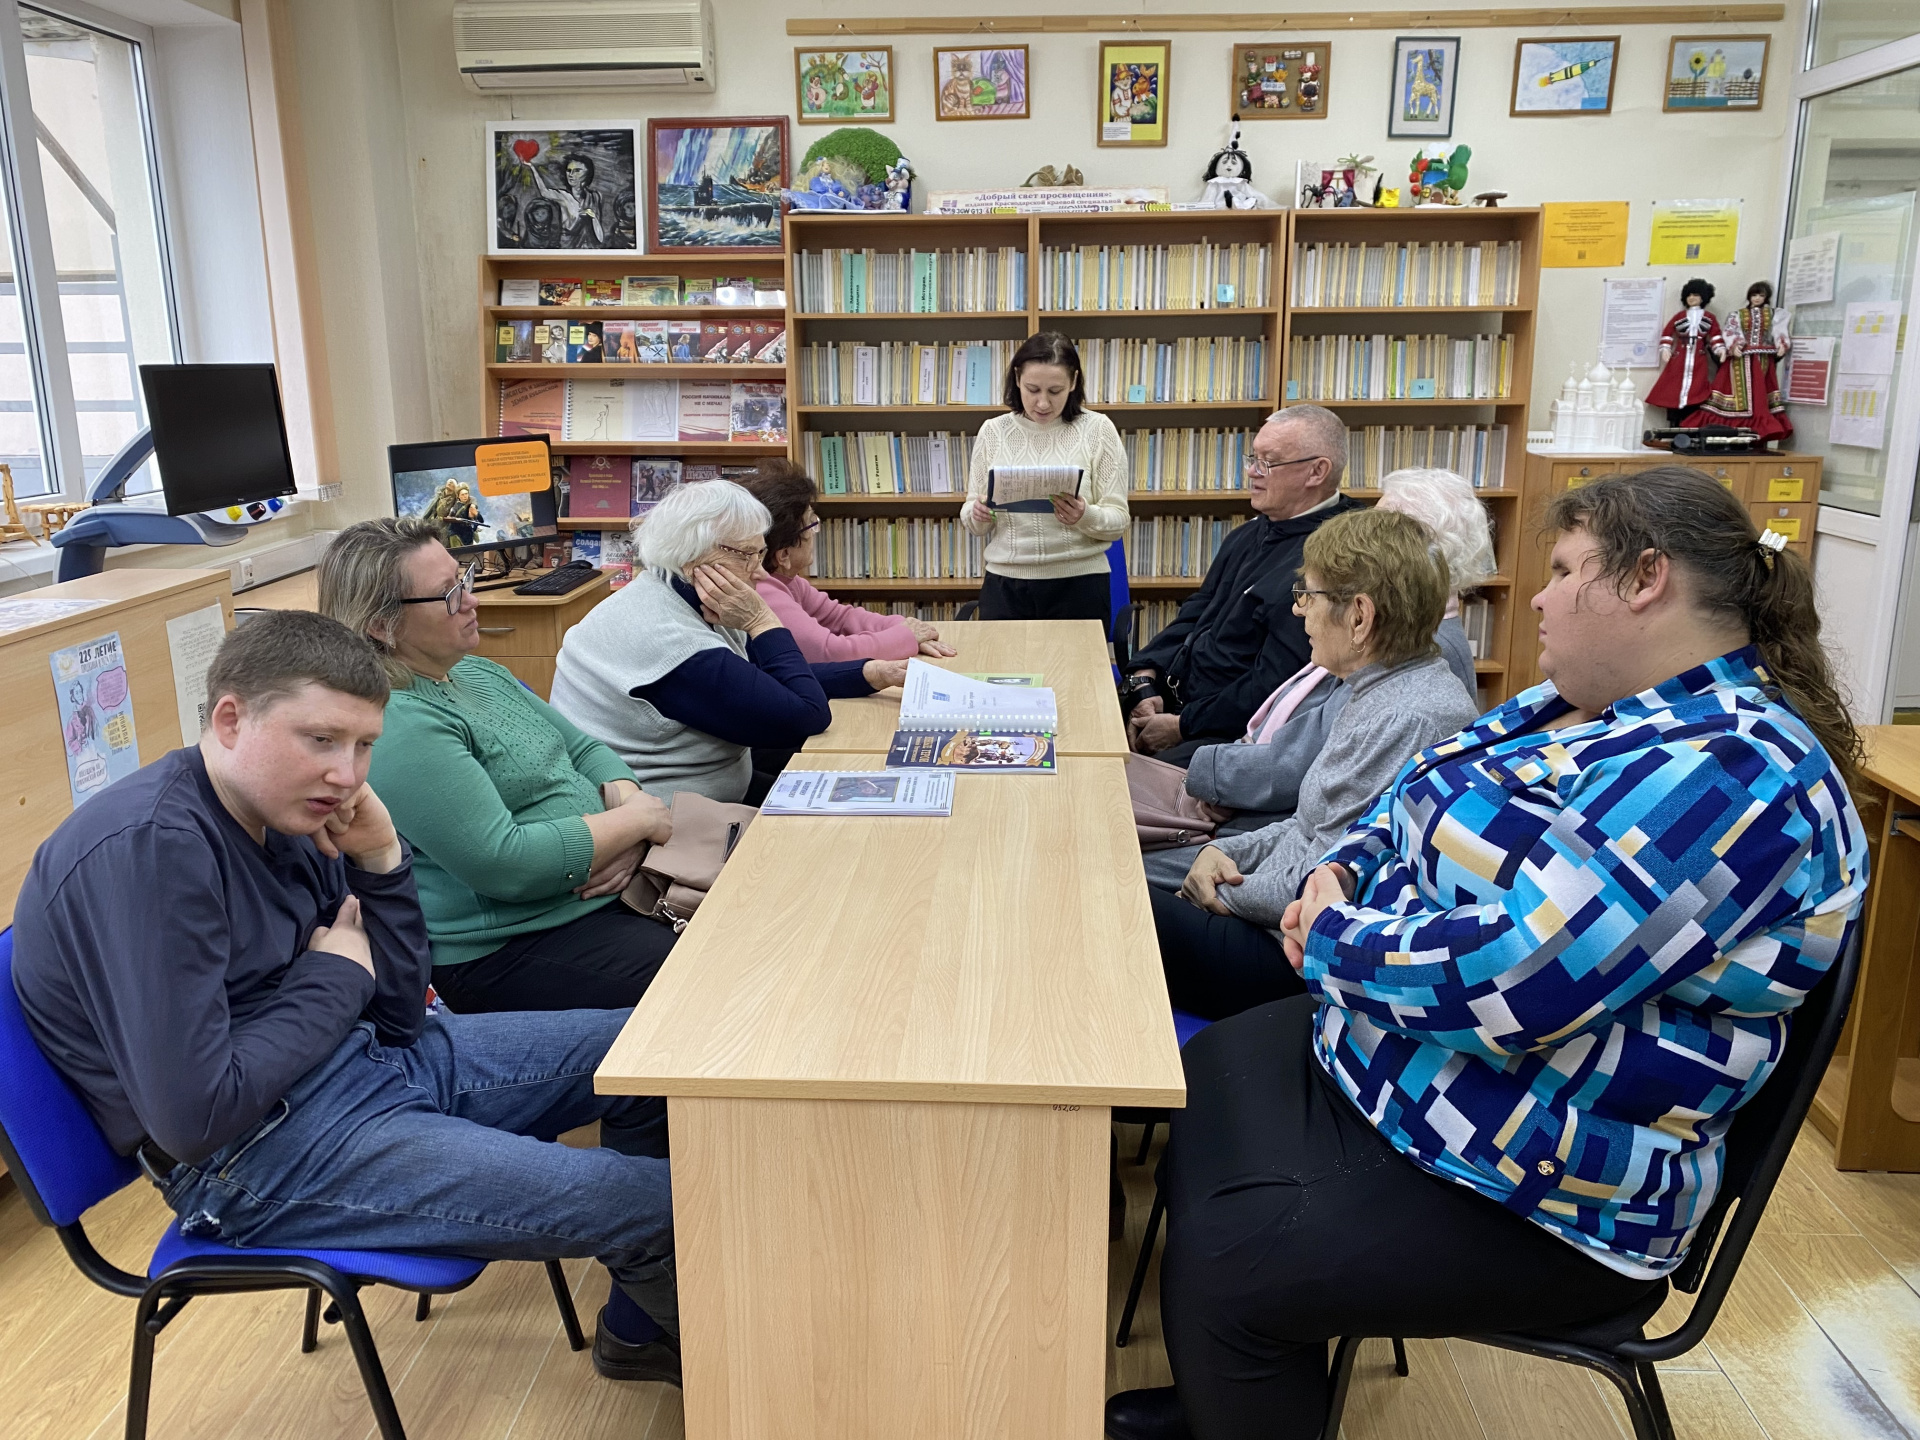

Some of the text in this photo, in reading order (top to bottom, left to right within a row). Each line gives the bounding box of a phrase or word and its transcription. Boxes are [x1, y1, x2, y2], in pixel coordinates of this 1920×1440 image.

[975, 192, 1016, 201] «Добрый
[686, 470, 717, 479] ПИКУЛЬ
[79, 648, 91, 664] 225
[94, 641, 116, 658] ЛЕТИЕ
